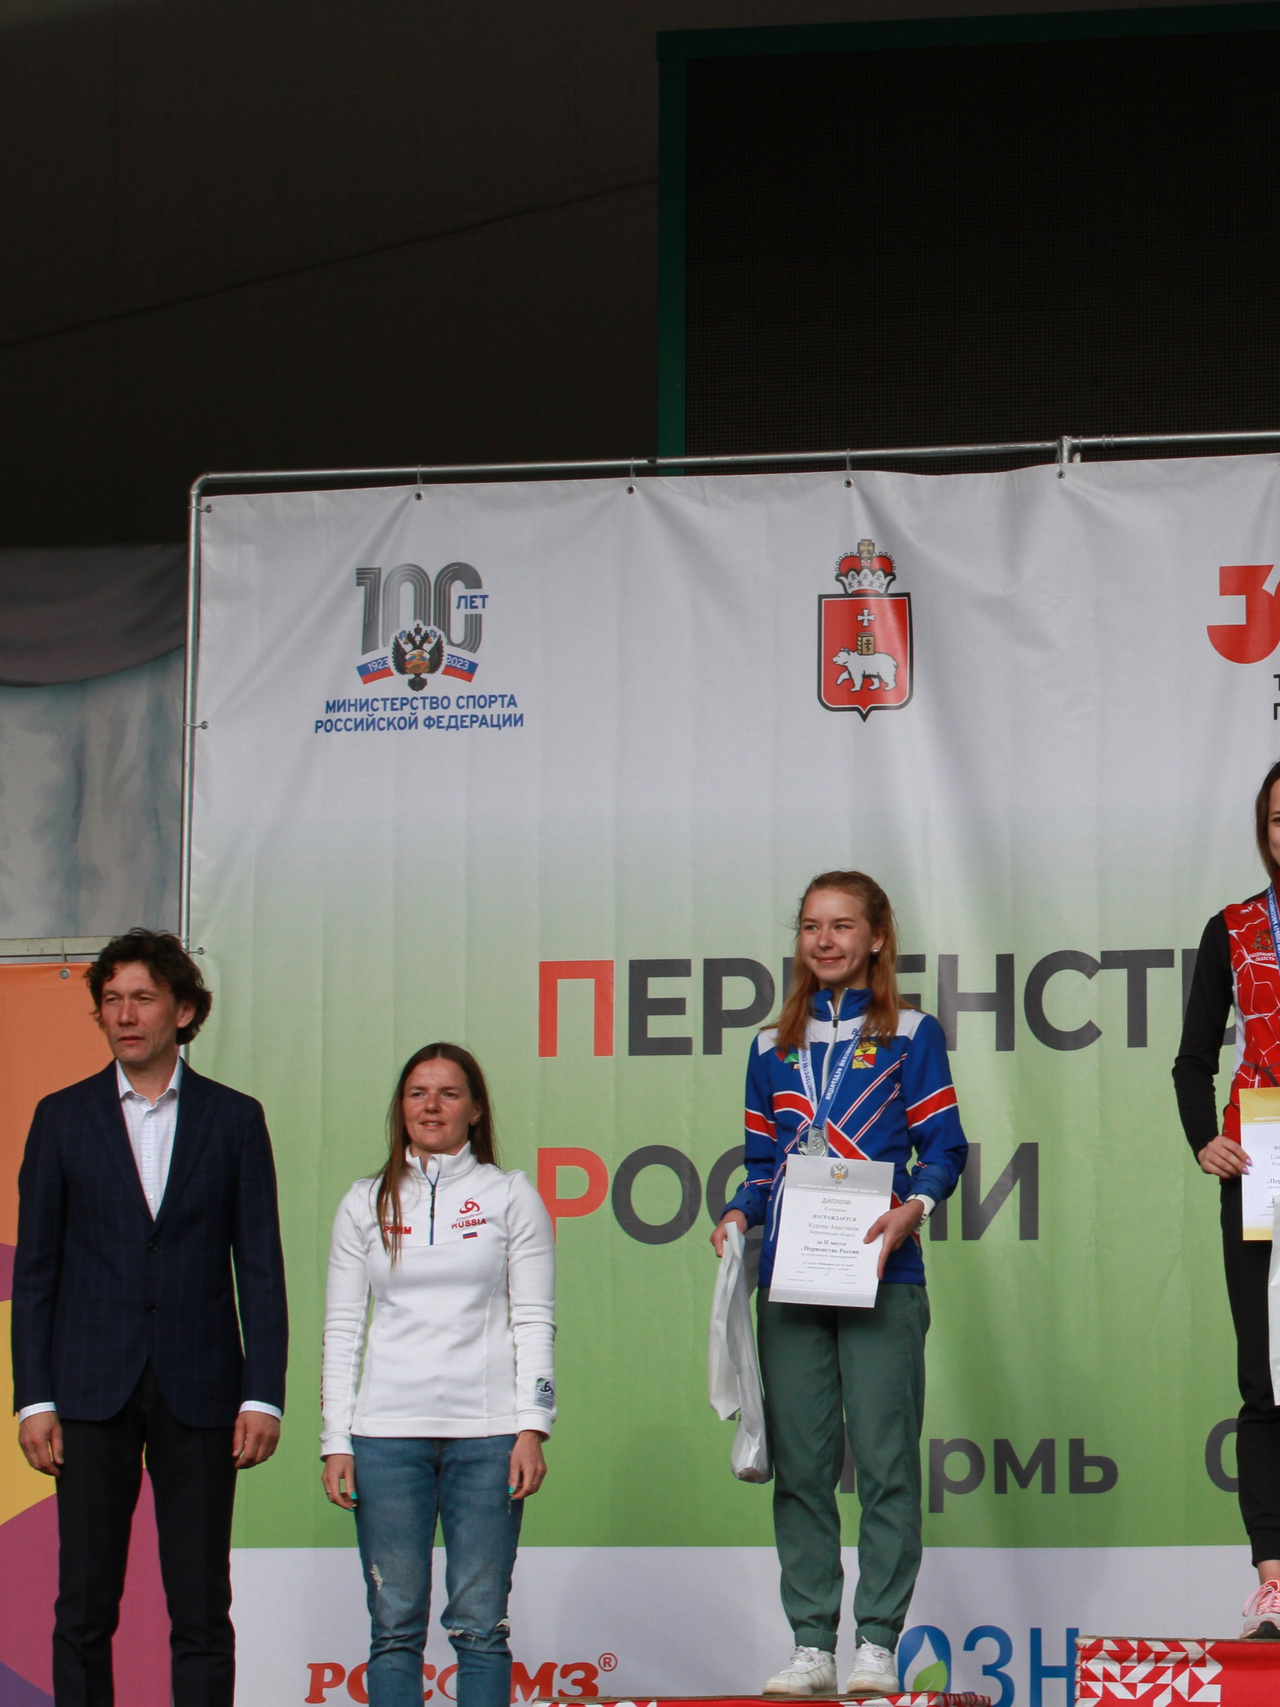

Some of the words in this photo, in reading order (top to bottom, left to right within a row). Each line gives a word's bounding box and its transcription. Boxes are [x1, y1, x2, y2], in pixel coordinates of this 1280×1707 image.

[356, 561, 483, 655] 100
[456, 594, 489, 610] ЛЕТ
[367, 656, 390, 673] 1923
[446, 654, 470, 671] 2023
[325, 695, 451, 714] МИНИСТЕРСТВО
[456, 694, 518, 711] СПОРТА
[314, 711, 419, 734] РОССИЙСКОЙ
[423, 713, 524, 732] ФЕДЕРАЦИИ
[821, 1197, 851, 1206] ДИПЛОМ
[812, 1214, 857, 1222] НАГРАЖДАЕТСЯ
